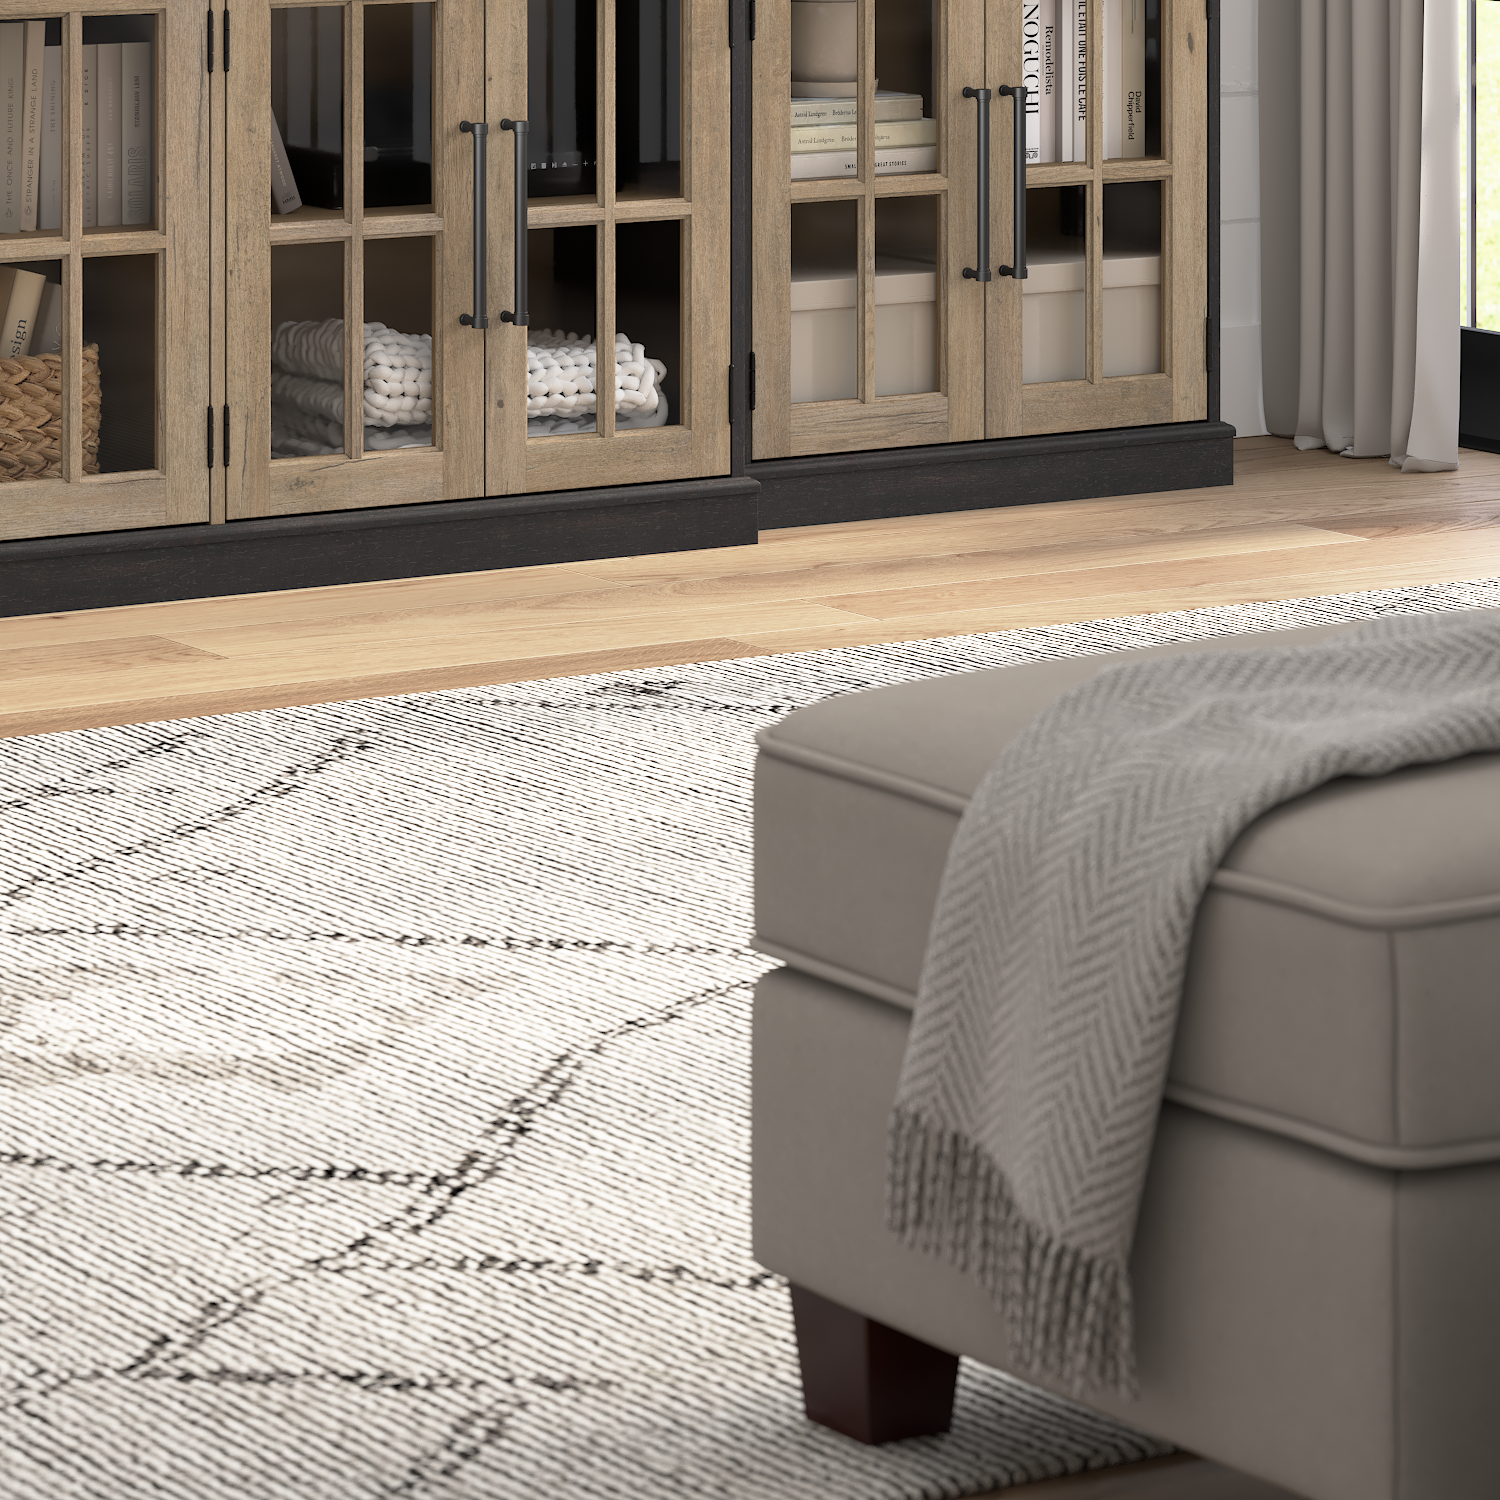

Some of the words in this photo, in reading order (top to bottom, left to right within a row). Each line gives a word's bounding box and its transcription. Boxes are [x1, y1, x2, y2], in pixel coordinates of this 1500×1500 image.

[1022, 3, 1040, 115] NOGUCHI
[1045, 25, 1054, 95] Remodelista
[29, 95, 37, 134] STRANGE
[794, 111, 808, 119] Astrid
[808, 110, 827, 119] Lindgren
[1126, 91, 1135, 140] Chipperfield
[28, 146, 34, 156] IN
[29, 136, 35, 144] A
[26, 159, 34, 203] STRANGER
[127, 145, 147, 221] SOLARIS
